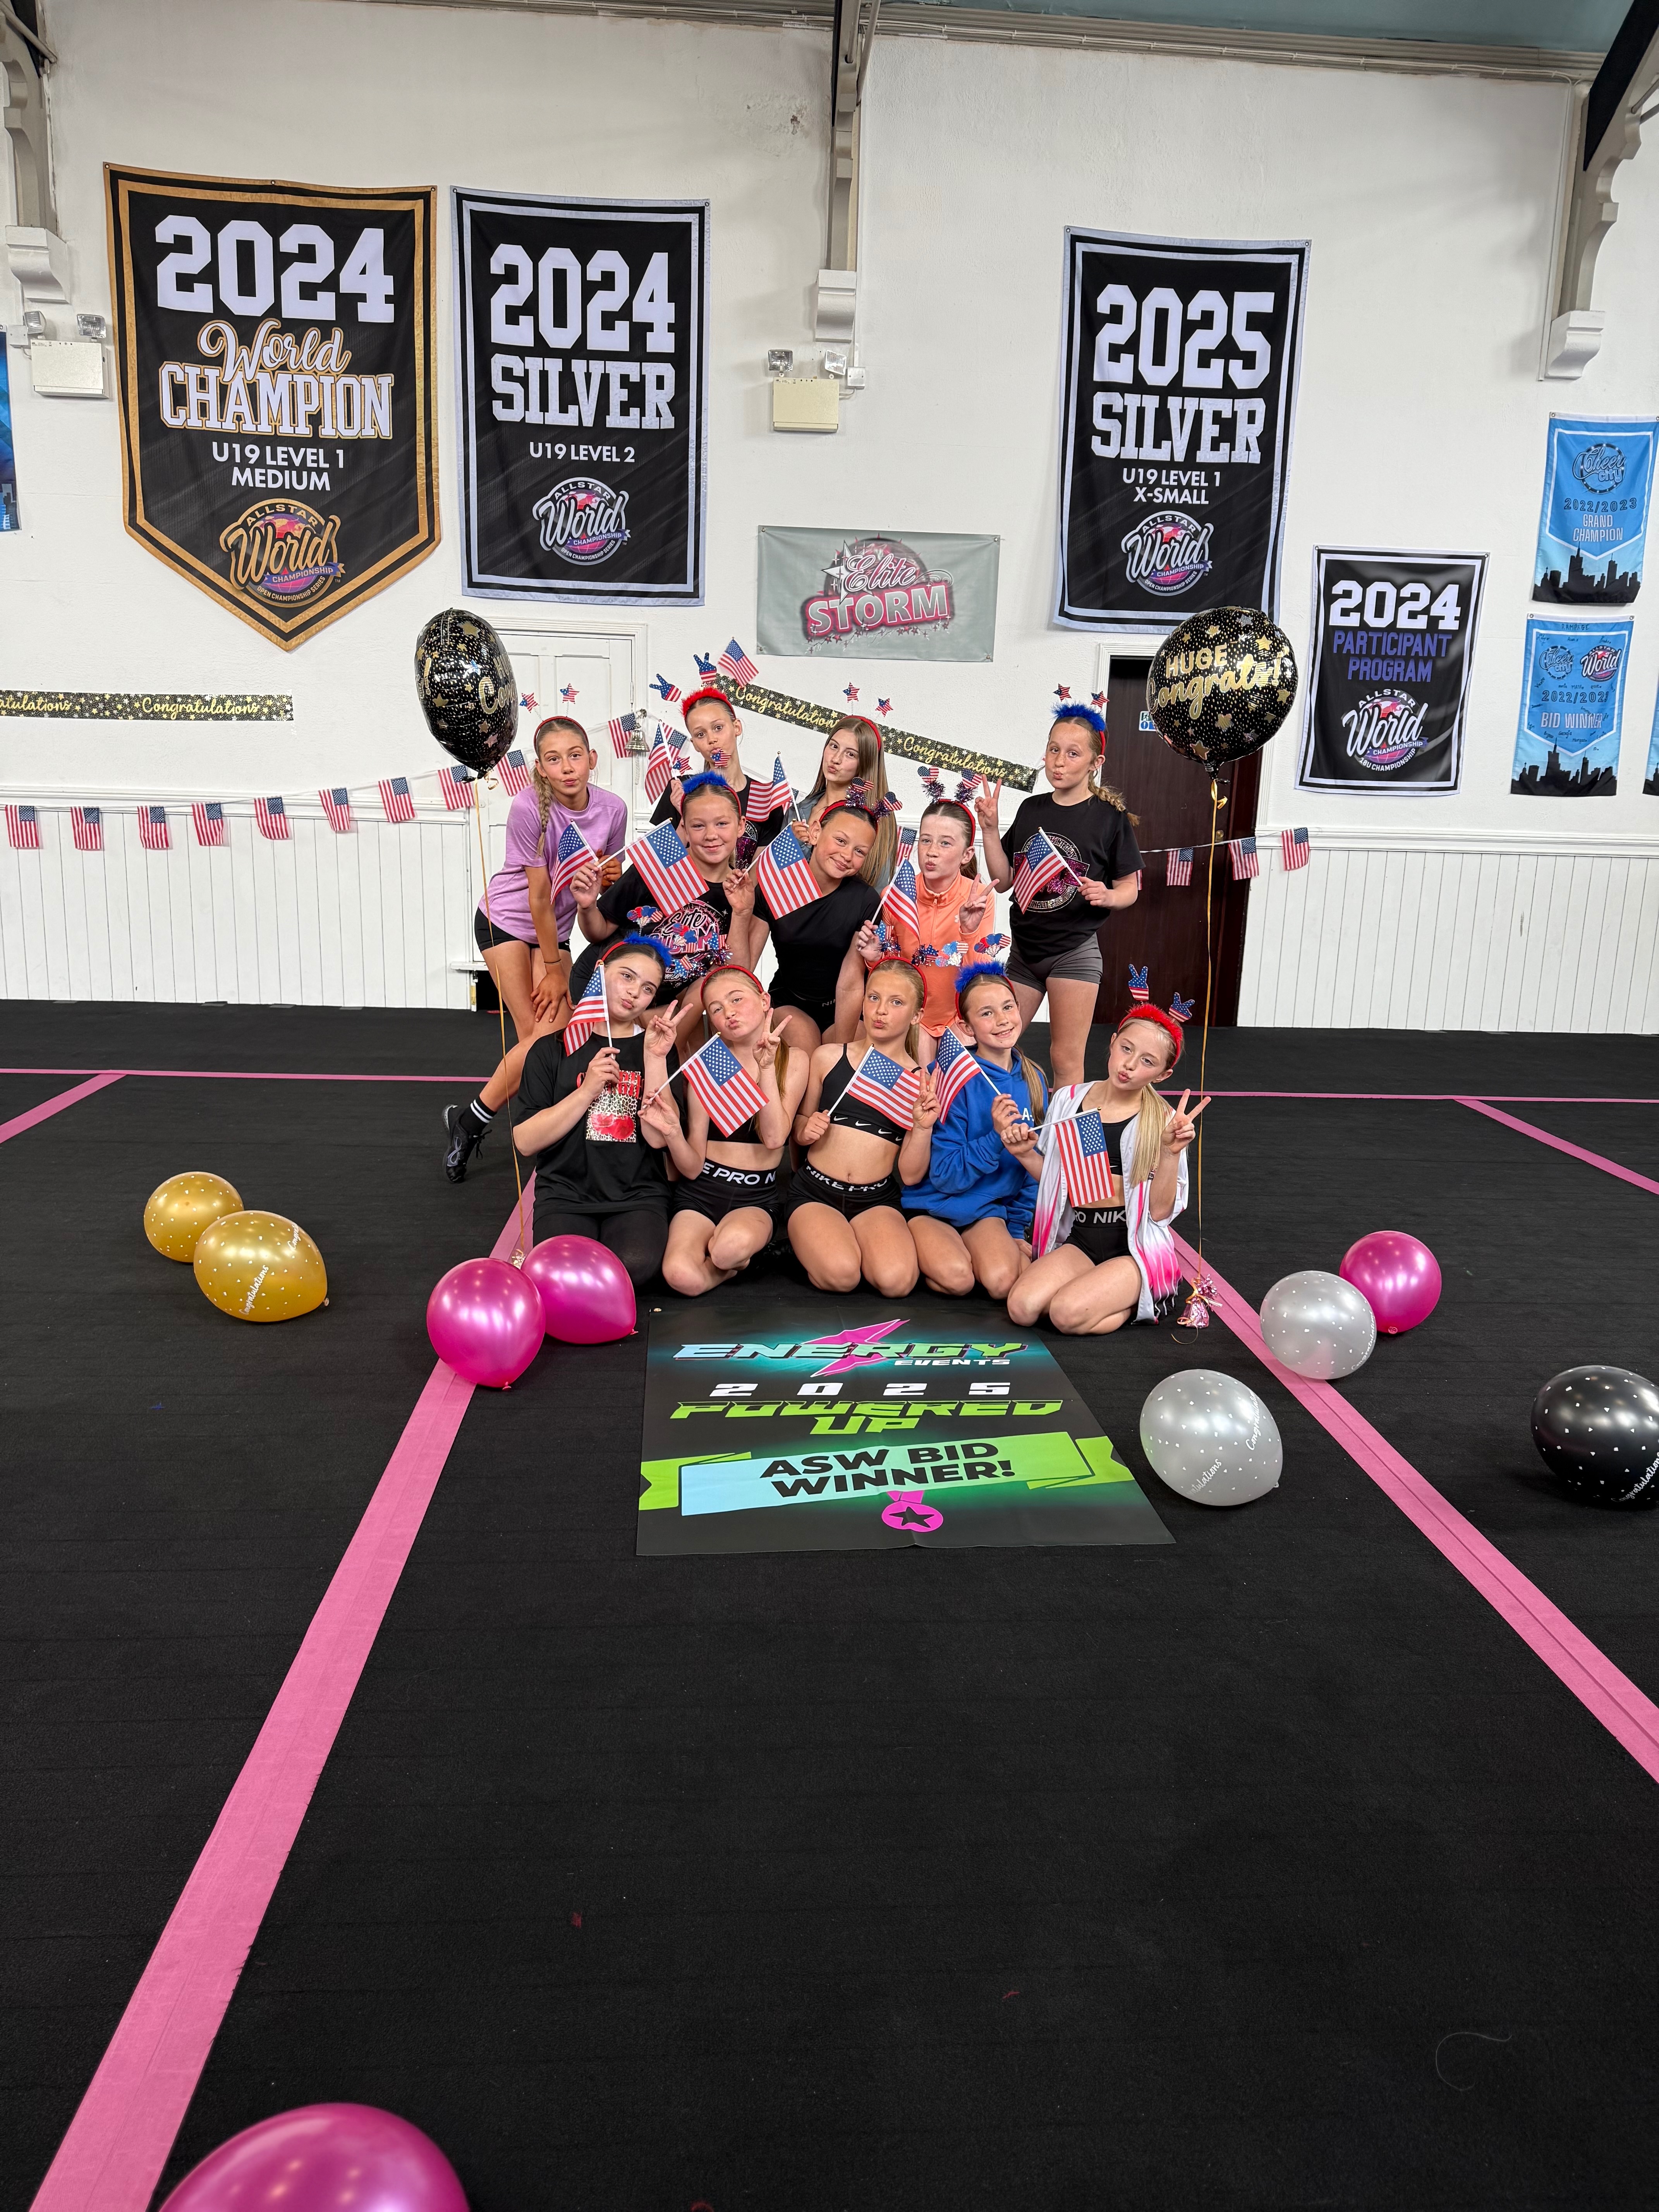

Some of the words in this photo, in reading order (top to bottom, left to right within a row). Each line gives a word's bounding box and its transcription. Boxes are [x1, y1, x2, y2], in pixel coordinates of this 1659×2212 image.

[155, 215, 394, 323] 2024
[490, 244, 675, 353] 2024
[1093, 284, 1275, 389] 2025
[198, 318, 351, 383] World
[160, 362, 393, 439] CHAMPION
[491, 353, 675, 429] SILVER
[1091, 392, 1266, 464] SILVER
[213, 441, 262, 465] U19
[266, 446, 329, 469] LEVEL
[336, 449, 344, 469] 1
[530, 441, 567, 459] U19
[571, 444, 620, 462] LEVEL
[624, 447, 635, 463] 2
[1573, 446, 1626, 480] Cheer
[232, 467, 331, 491] MEDIUM
[1123, 468, 1158, 484] U19
[1162, 469, 1209, 486] LEVEL
[1214, 471, 1221, 487] 1
[1598, 467, 1623, 483] city
[554, 482, 611, 500] ALLSTAR
[1133, 486, 1209, 504] X-SMALL
[247, 504, 318, 527] ALLSTAR
[1564, 498, 1637, 513] 2022/2023
[539, 496, 623, 546] World
[1142, 515, 1196, 534] ALLSTAR
[1583, 514, 1613, 527] GRAND
[573, 532, 622, 545] CHAMPIONSHIP
[1573, 527, 1623, 542] CHAMPION
[227, 521, 333, 585] World
[561, 548, 572, 557] OPEN
[572, 551, 604, 560] CHAMPIONSHIP
[604, 540, 615, 553] SERIES
[1126, 527, 1208, 578] World
[272, 567, 333, 583] CHAMPIONSHIP
[844, 553, 916, 592] Elite
[1157, 564, 1204, 577] CHAMPIONSHIP
[257, 586, 271, 598] OPEN
[271, 590, 311, 601] CHAMPIONSHIP
[311, 576, 325, 592] SERIES
[1145, 579, 1154, 589] OPEN
[808, 585, 948, 634] STORM
[1329, 580, 1461, 630] 2024
[1333, 630, 1452, 657] PARTICIPANT
[1589, 646, 1615, 655] ALLSTAR
[1166, 642, 1228, 678] HUGE
[1348, 657, 1432, 682] PROGRAM
[1540, 648, 1574, 670] Cheer
[1581, 649, 1621, 677] World
[142, 697, 260, 720] Congratulations
[1358, 689, 1416, 709] ALLSTAR
[1342, 702, 1428, 757] World
[1541, 712, 1561, 728] BID
[903, 737, 1007, 777] Congratulations
[1359, 757, 1372, 768] 18U
[1371, 748, 1416, 771] CHAMPIONSHIP
[1373, 741, 1423, 755] CHAMPIONSHIP
[712, 1168, 760, 1185] PRO
[1093, 1210, 1127, 1224] NIK
[673, 1342, 1025, 1359] ENERGY
[670, 1400, 1063, 1419] POWERED
[810, 1416, 920, 1434] UP
[759, 1449, 890, 1479] ASW
[907, 1443, 999, 1464] BID
[771, 1460, 1015, 1498] WINNER!
